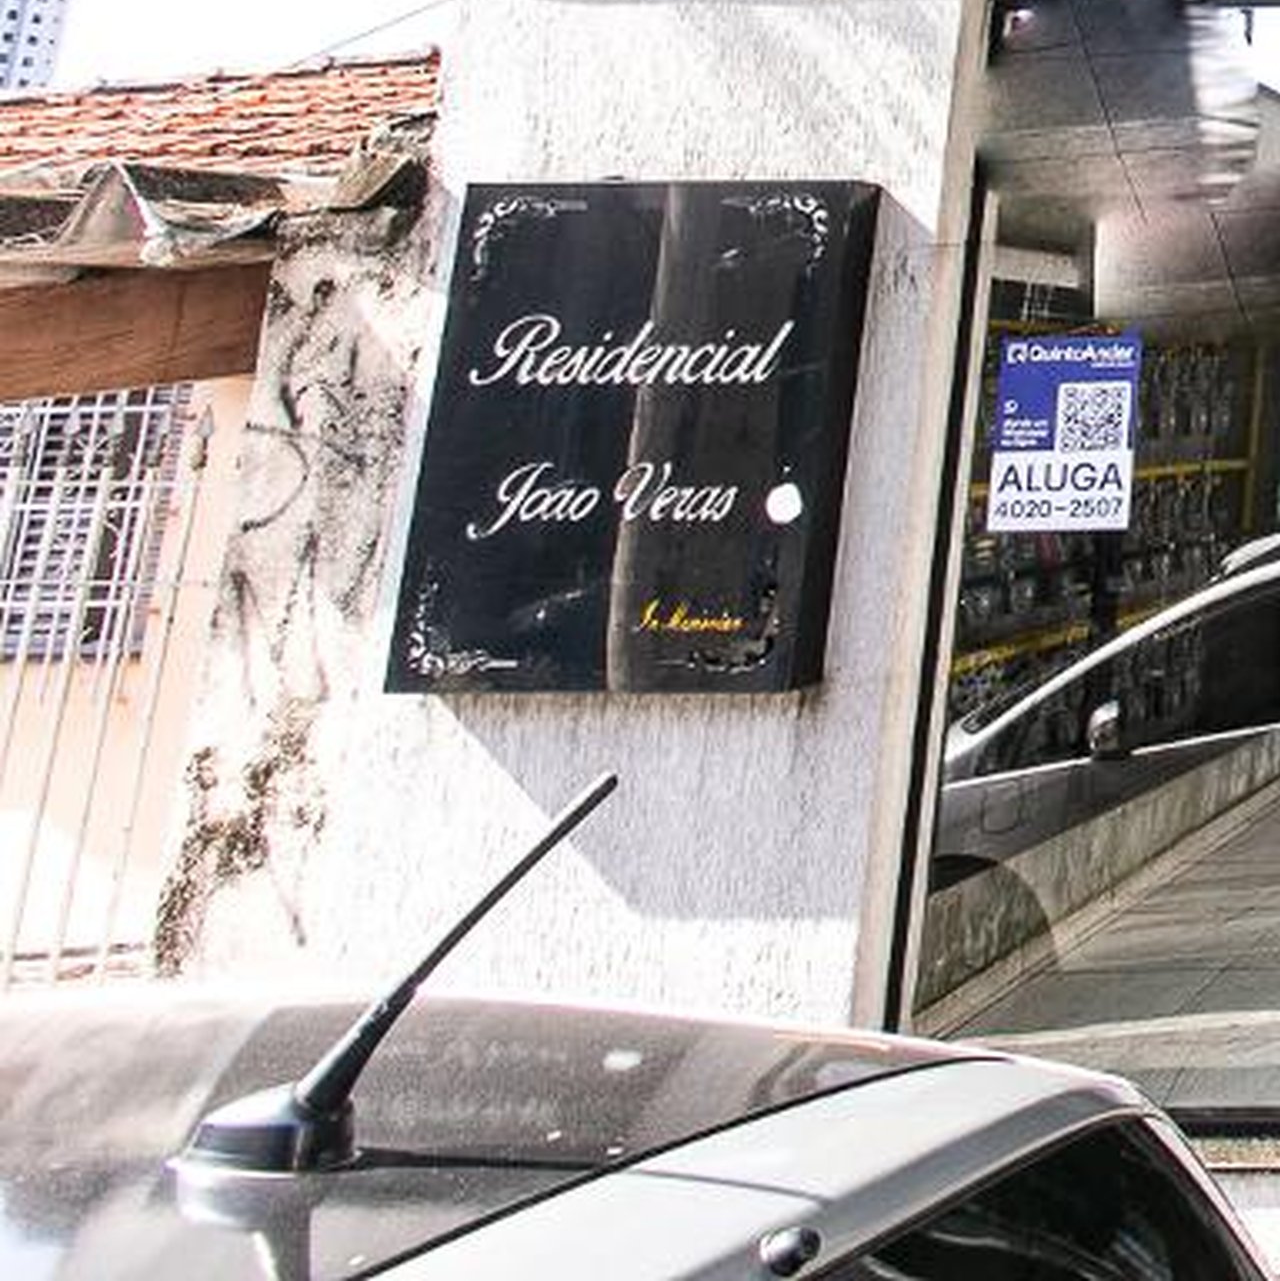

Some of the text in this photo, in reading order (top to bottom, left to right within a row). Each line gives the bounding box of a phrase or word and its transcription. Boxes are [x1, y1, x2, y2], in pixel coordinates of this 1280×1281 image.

[470, 313, 795, 386] Residencial
[613, 462, 738, 521] Veras
[998, 463, 1122, 492] ALUGA
[994, 497, 1122, 519] 4020-2507
